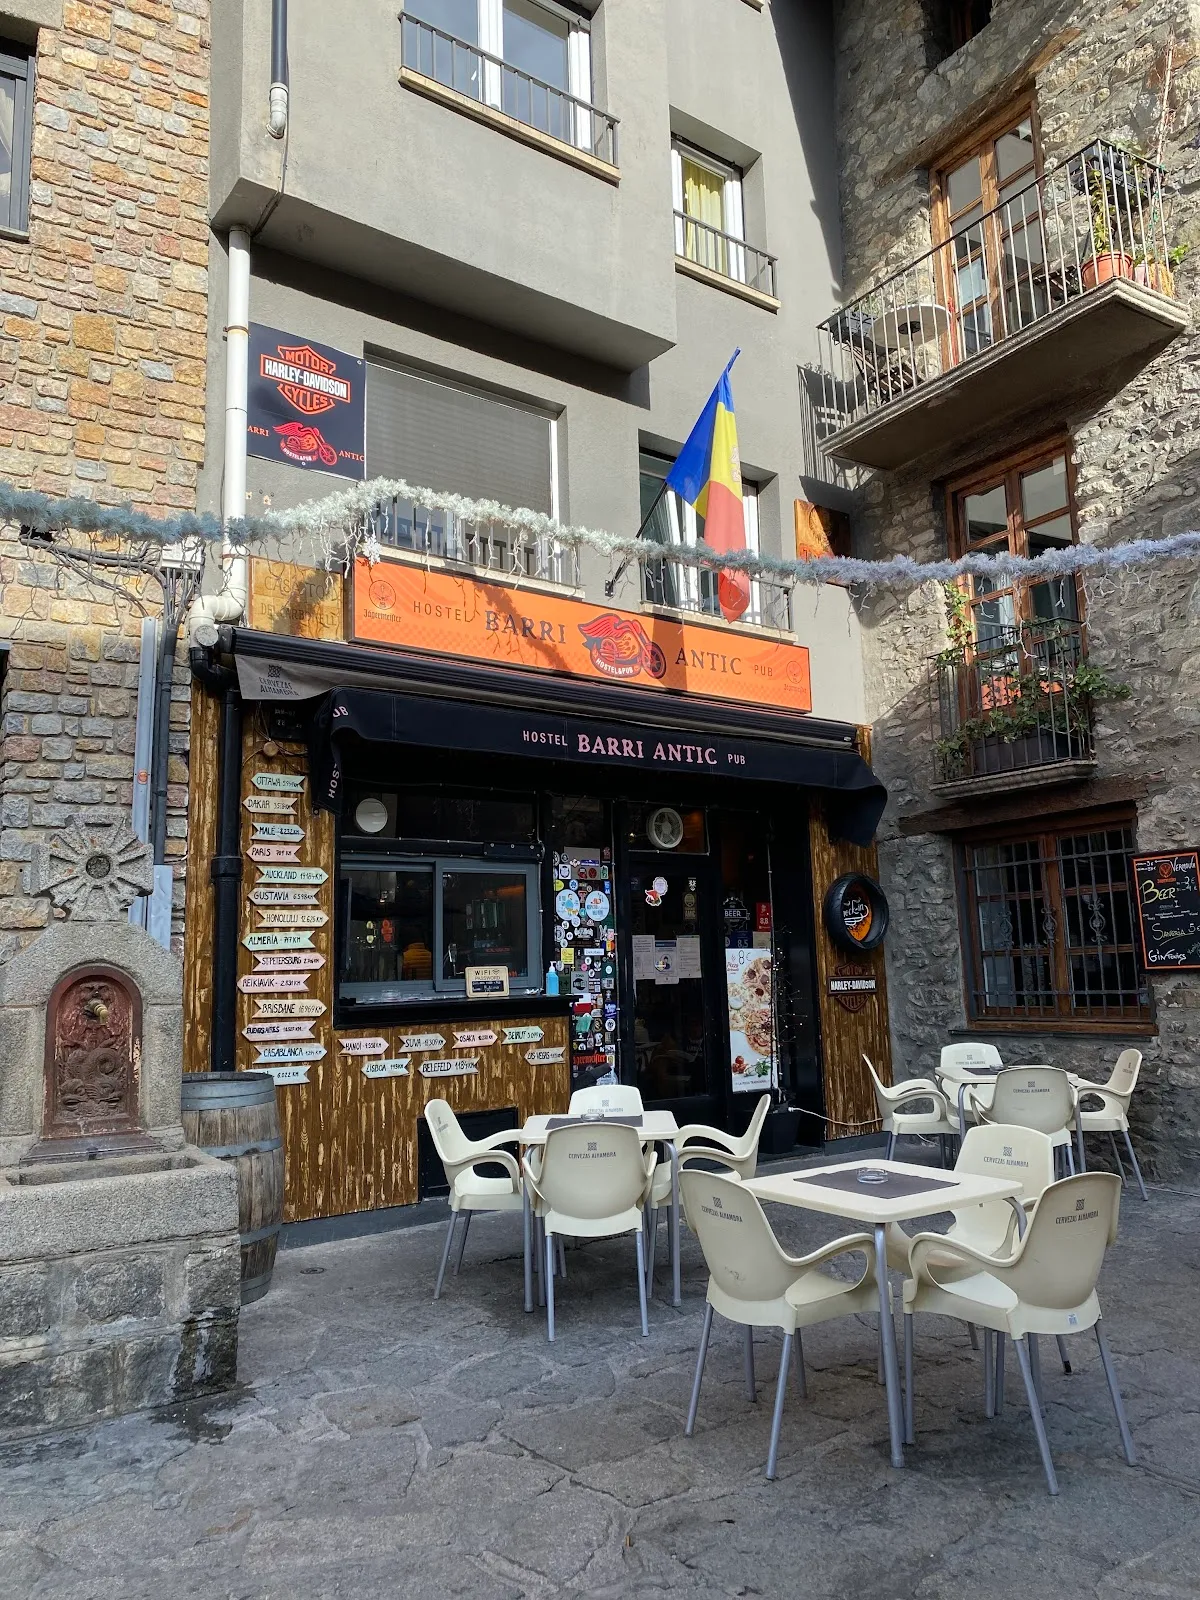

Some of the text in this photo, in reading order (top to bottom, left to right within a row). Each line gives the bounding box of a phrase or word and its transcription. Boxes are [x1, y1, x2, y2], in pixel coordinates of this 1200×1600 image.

[286, 350, 333, 374] MOTOR
[265, 359, 347, 399] HARLEY-DAVIDSON
[284, 385, 328, 411] CYCLES
[247, 425, 270, 437] ARRI
[339, 450, 365, 462] ANTIC
[413, 600, 773, 677] HOSTEL BARRI ANTIC PUB
[522, 730, 746, 765] HOSTEL BARRI ANTIC PUB
[247, 799, 270, 809] DAKAR
[251, 847, 271, 857] PARIS
[265, 870, 297, 880] AUCKLAND
[253, 891, 289, 901] GUSTAVIA
[591, 1151, 617, 1159] ALHAMBRA
[983, 1156, 1029, 1167] CERVEZAS ALHAMBRA
[1055, 1210, 1098, 1224] CERVEZAS ALHAMBRA
